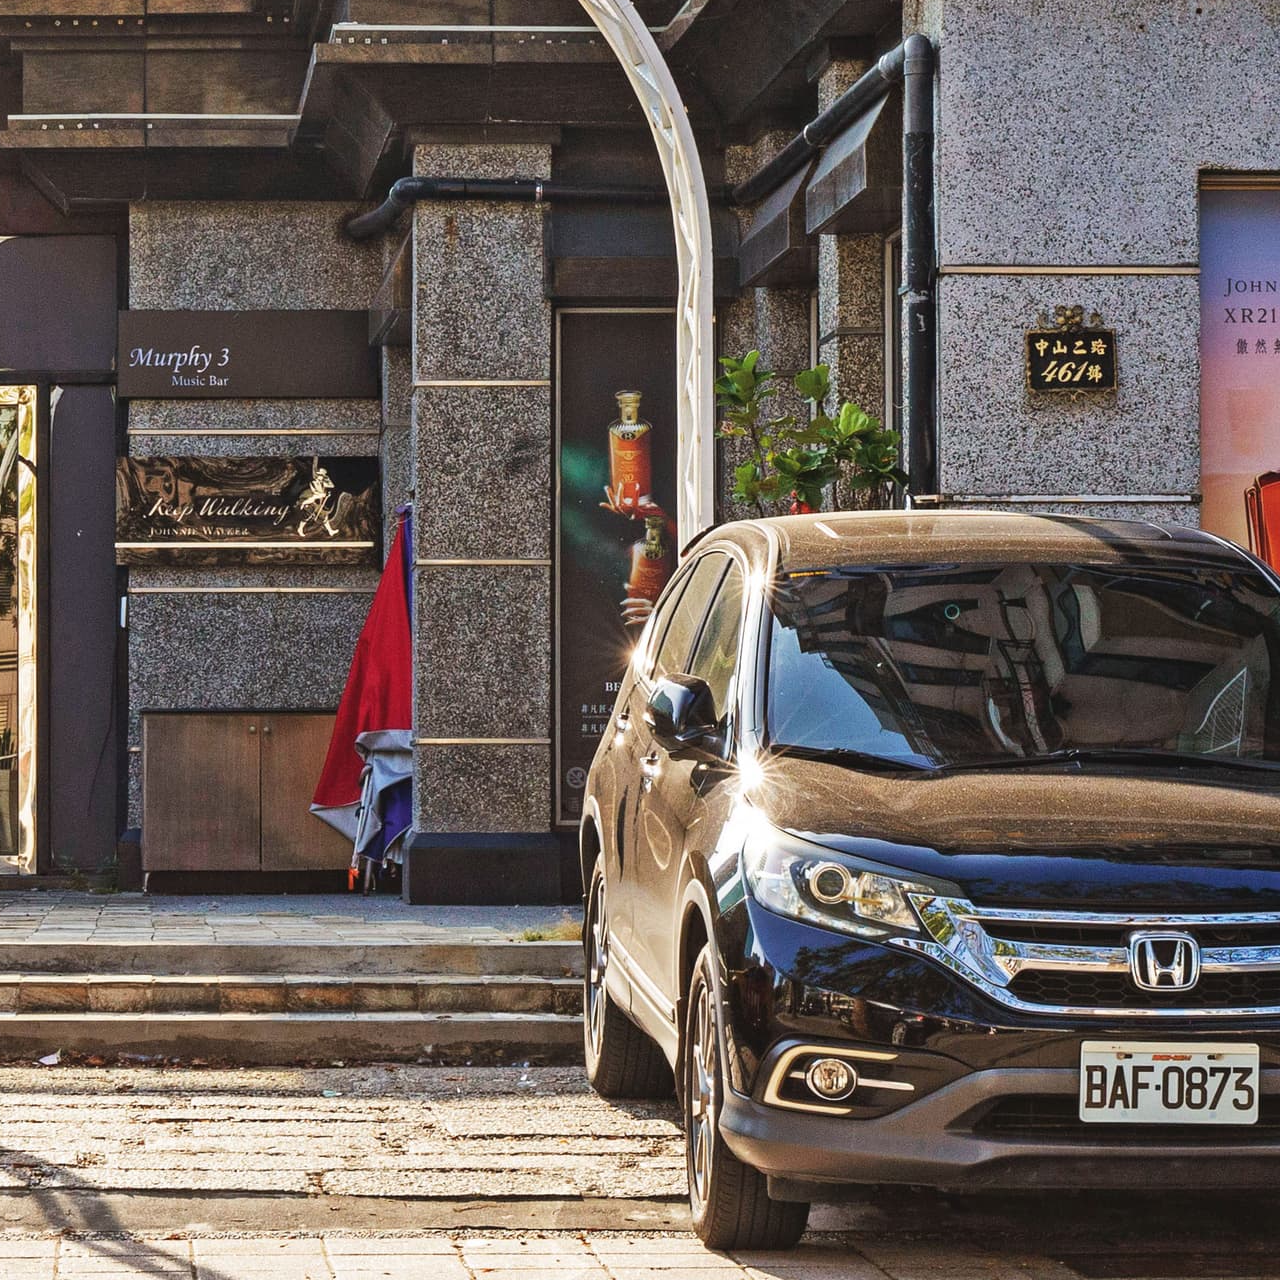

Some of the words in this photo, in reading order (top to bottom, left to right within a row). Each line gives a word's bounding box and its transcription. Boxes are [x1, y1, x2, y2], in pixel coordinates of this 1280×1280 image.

[1034, 338, 1108, 357] 中山二路
[128, 344, 213, 374] Murphy
[217, 347, 230, 367] 3
[171, 375, 206, 387] Music
[209, 375, 229, 387] Bar
[1040, 360, 1103, 383] 461號
[148, 497, 195, 522] Keep
[199, 497, 293, 526] Walking
[148, 526, 198, 538] JOHNNIE
